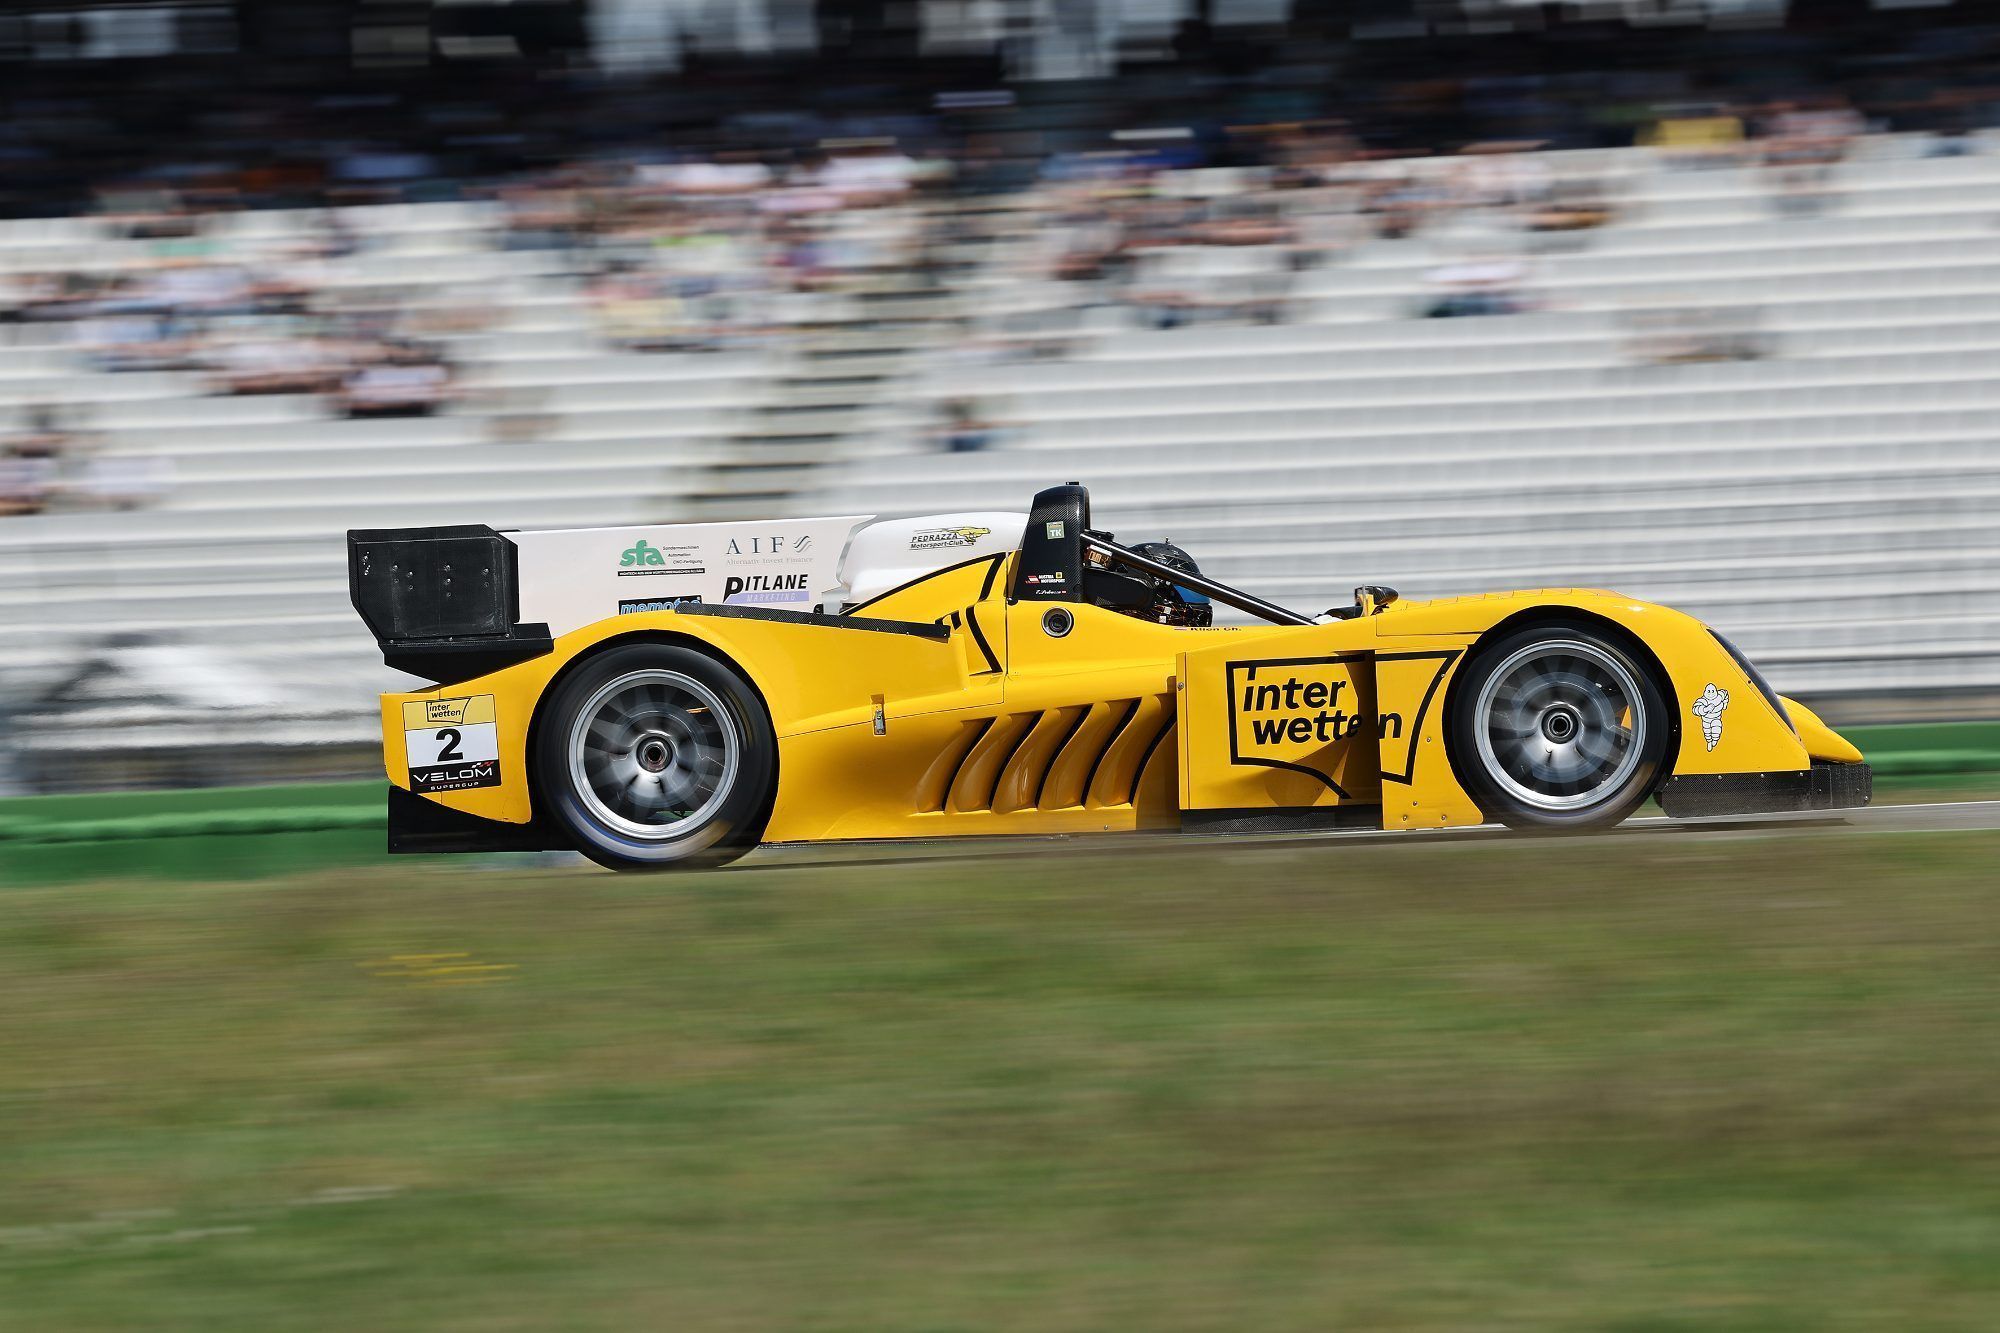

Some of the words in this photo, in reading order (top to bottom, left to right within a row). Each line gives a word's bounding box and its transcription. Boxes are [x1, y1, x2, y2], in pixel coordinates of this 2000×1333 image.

[911, 533, 958, 542] PEDRAZZA
[1049, 529, 1062, 537] TK
[910, 540, 964, 549] Motorsport-Club
[619, 540, 665, 566] sfa
[723, 574, 808, 603] PITLANE
[745, 593, 797, 602] MARKETING
[1243, 667, 1346, 712] inter
[429, 702, 451, 712] inter
[431, 709, 461, 718] wetten
[1252, 710, 1403, 745] wetten
[435, 728, 464, 762] 2
[413, 767, 493, 783] VELOM
[430, 781, 479, 791] SUPERCUP
